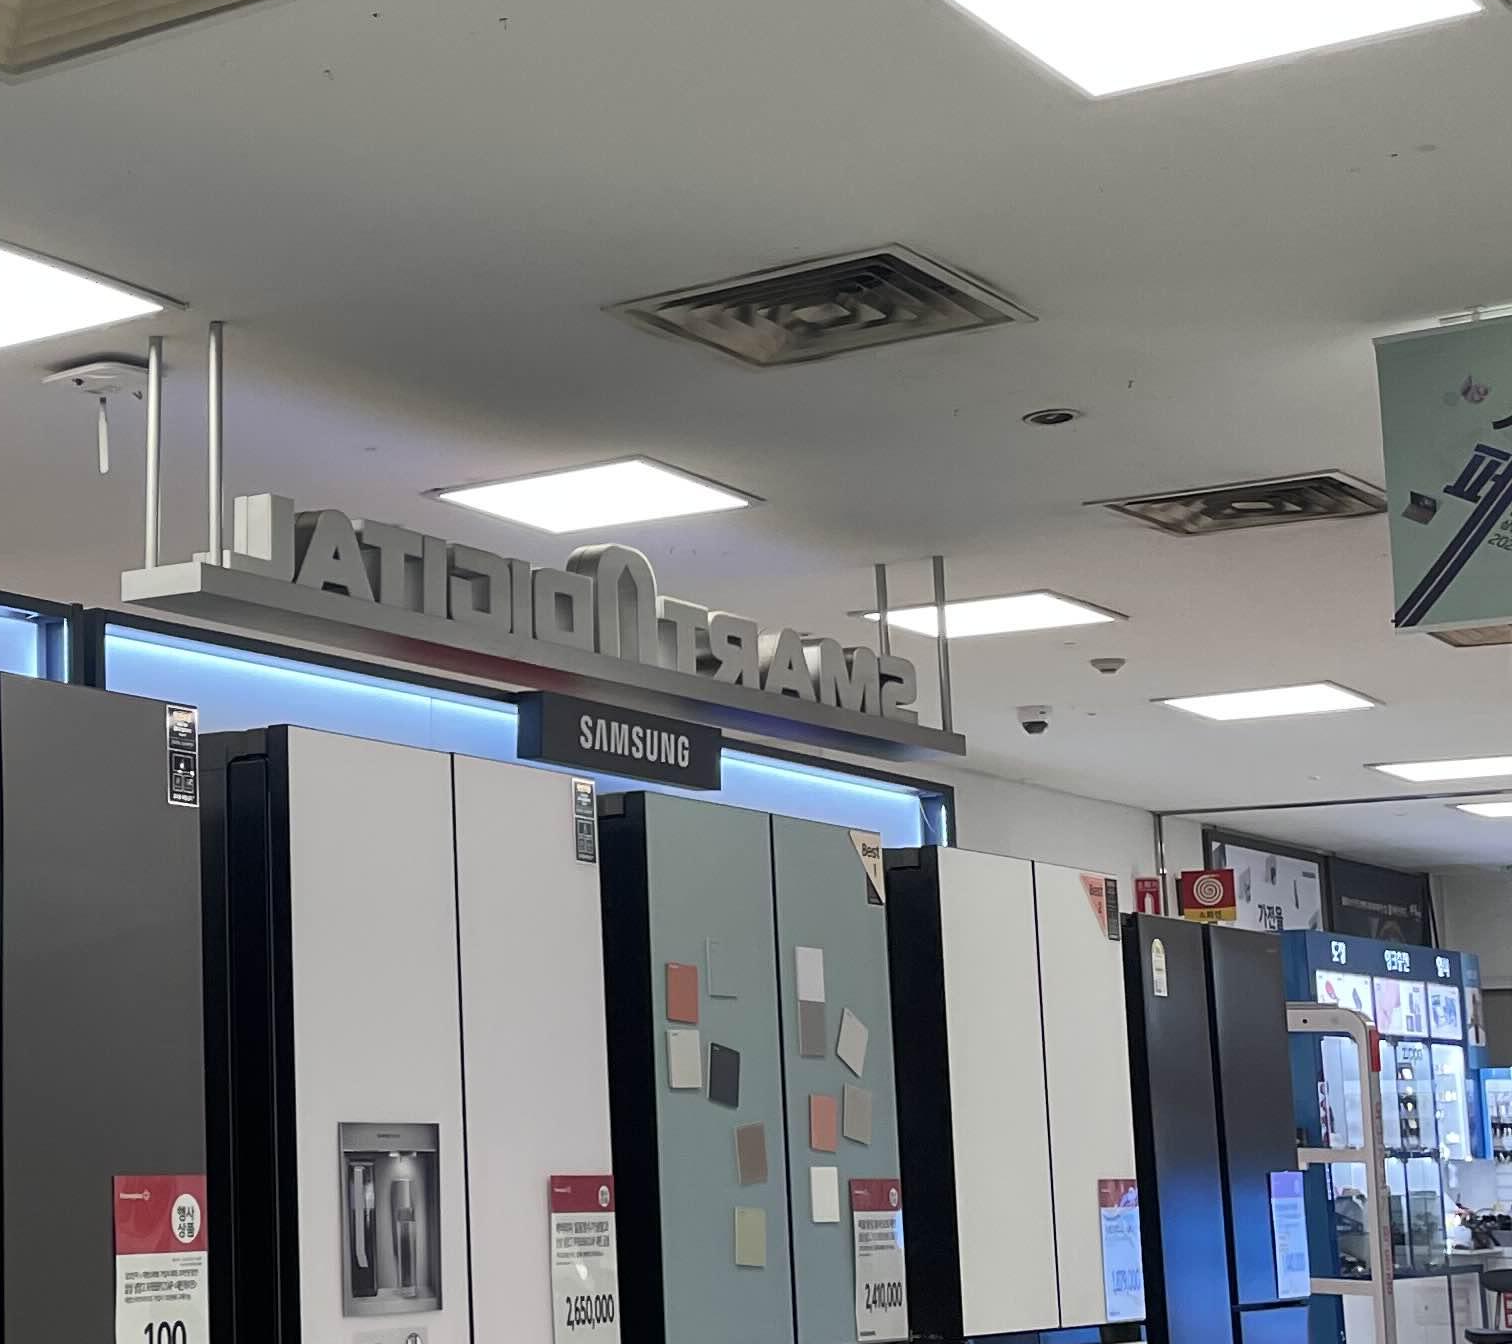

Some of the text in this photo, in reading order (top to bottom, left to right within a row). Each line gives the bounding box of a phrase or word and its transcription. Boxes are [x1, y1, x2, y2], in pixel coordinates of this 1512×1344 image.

[579, 715, 689, 768] SAMSUNG
[861, 843, 880, 859] Best
[566, 1294, 615, 1331] 2,650,000
